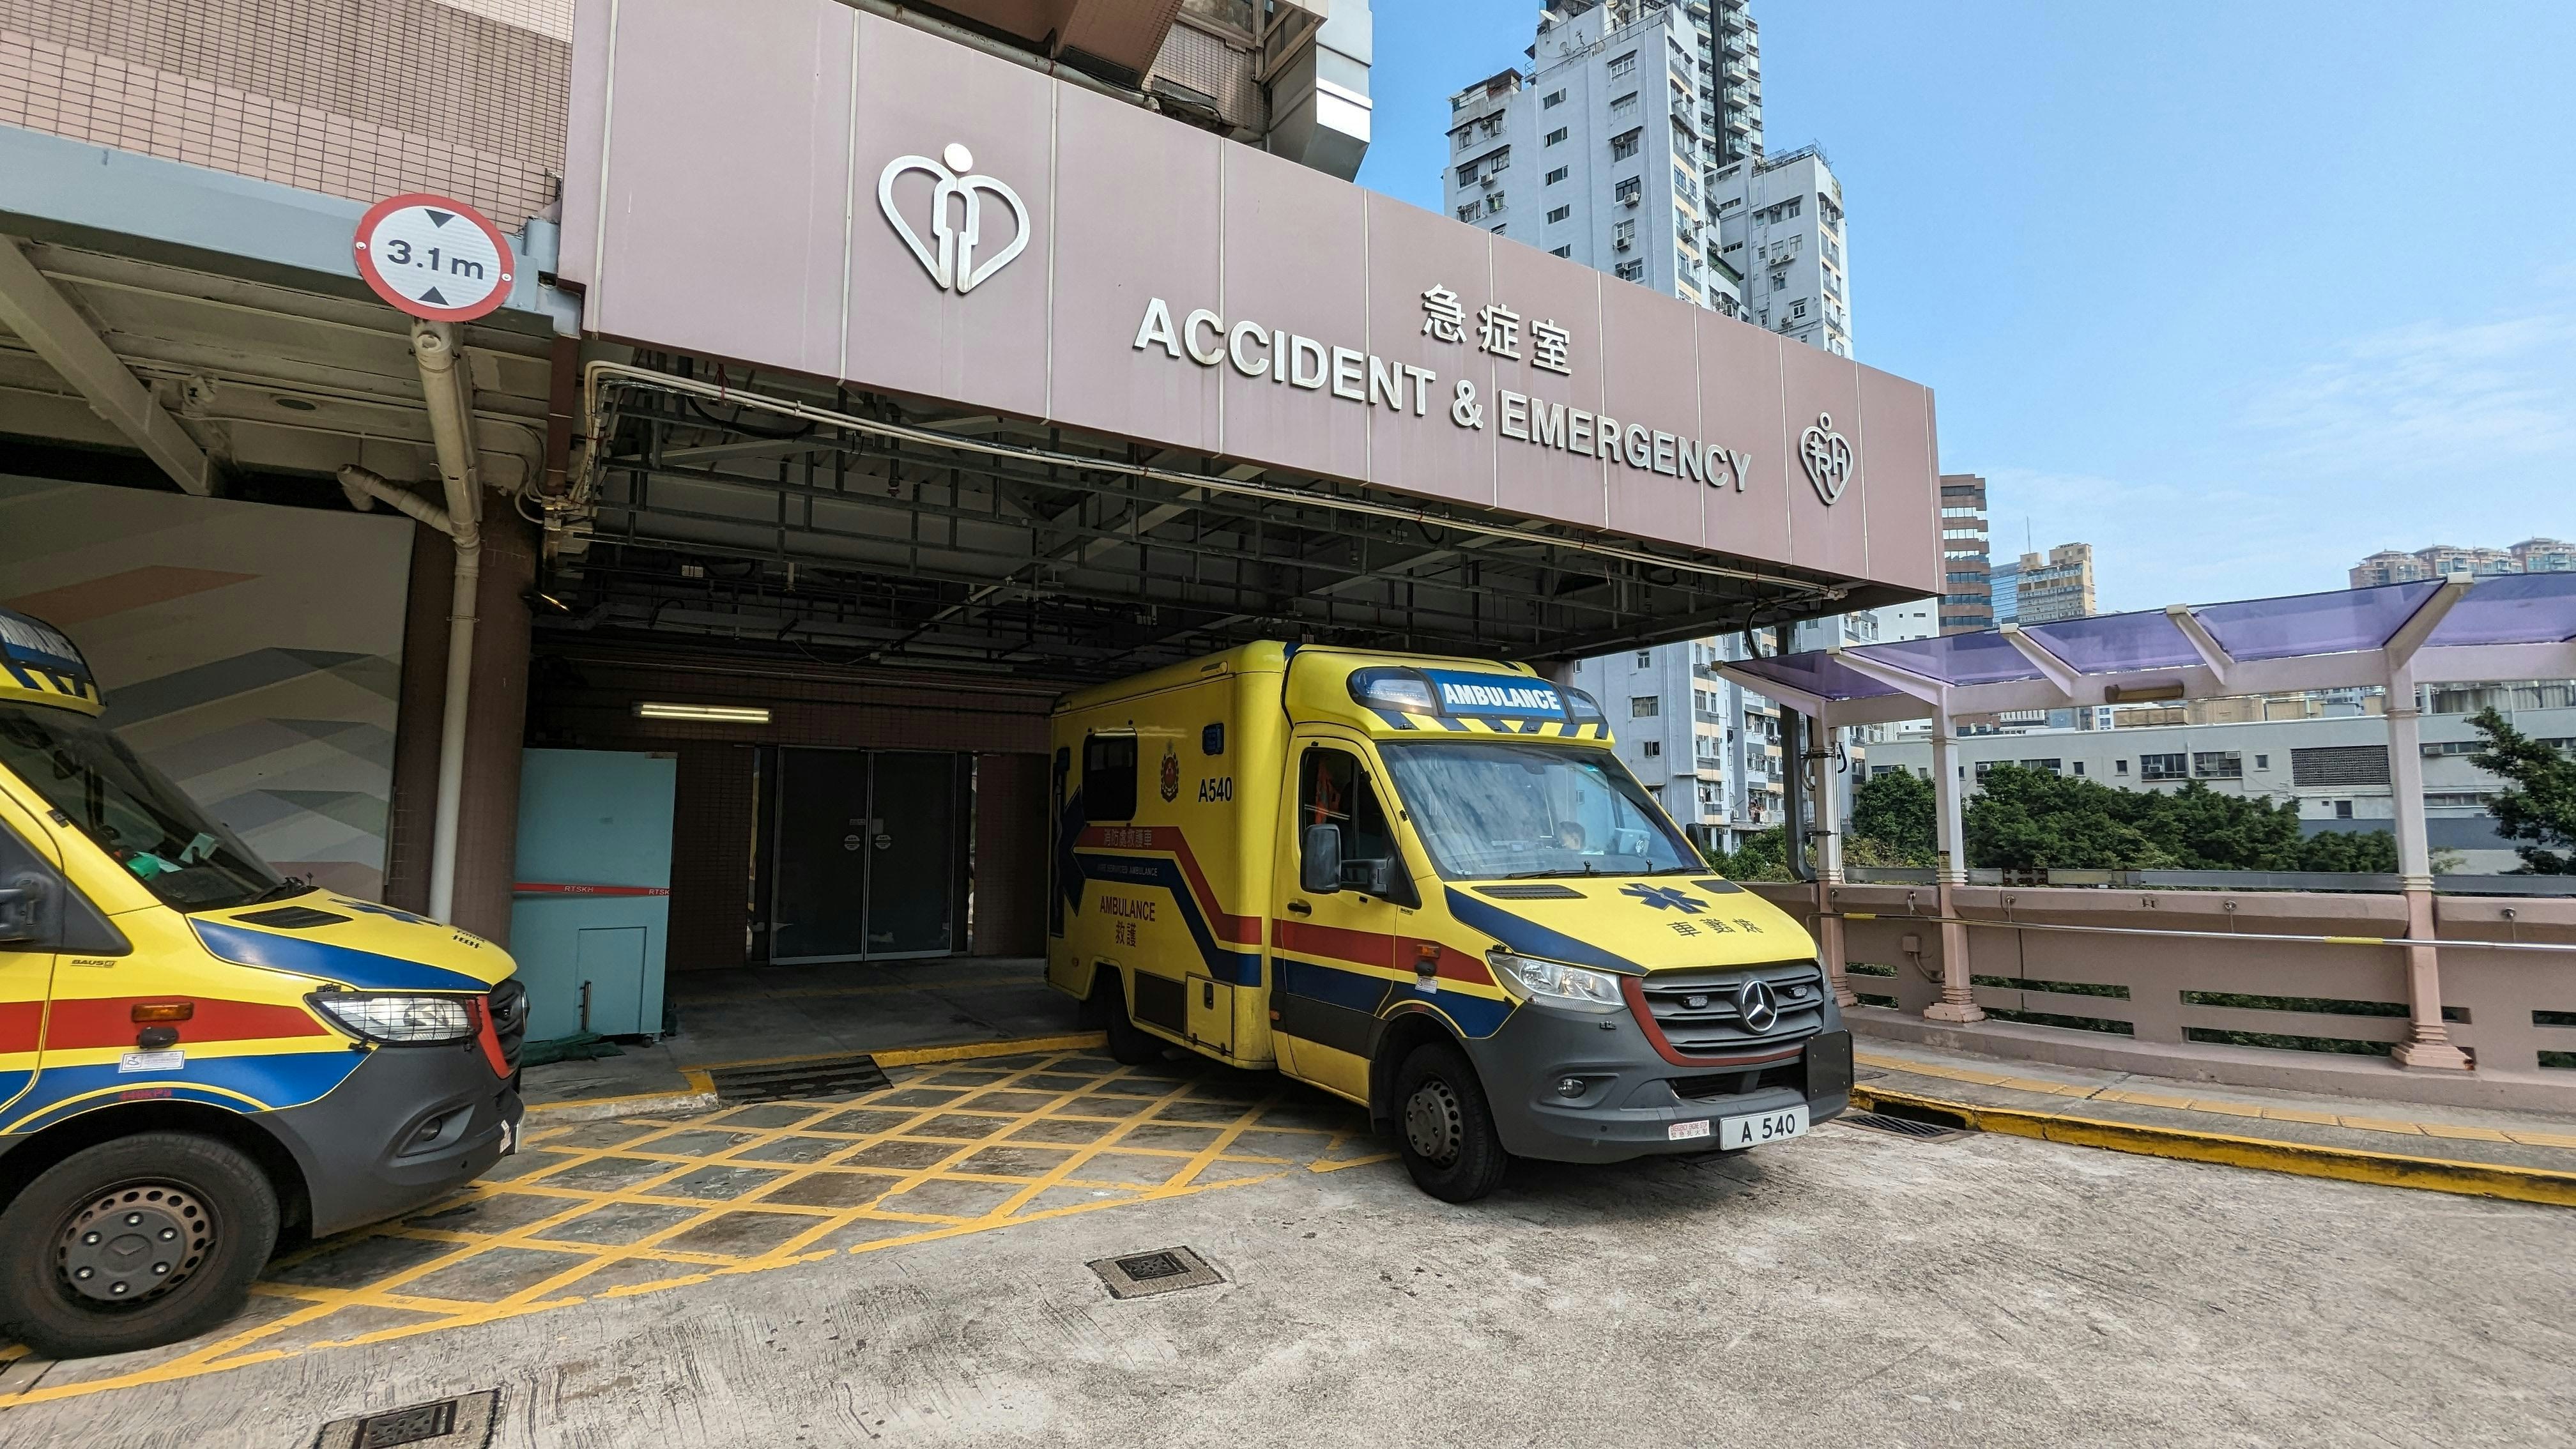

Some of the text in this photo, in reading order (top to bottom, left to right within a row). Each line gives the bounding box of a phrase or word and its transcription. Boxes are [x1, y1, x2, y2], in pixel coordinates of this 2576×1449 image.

[1421, 282, 1572, 376] 急症室
[1132, 297, 1752, 492] ACCIDENT & EMERGENCY
[2017, 569, 2082, 584] BEST WESTERN
[1443, 683, 1561, 710] AMBULANCE
[1198, 776, 1232, 802] A540
[1129, 866, 1158, 877] AMBULANCE
[1100, 895, 1156, 922] AMBULANCE
[1116, 920, 1136, 947] 救護
[1741, 1114, 1796, 1143] A 540
